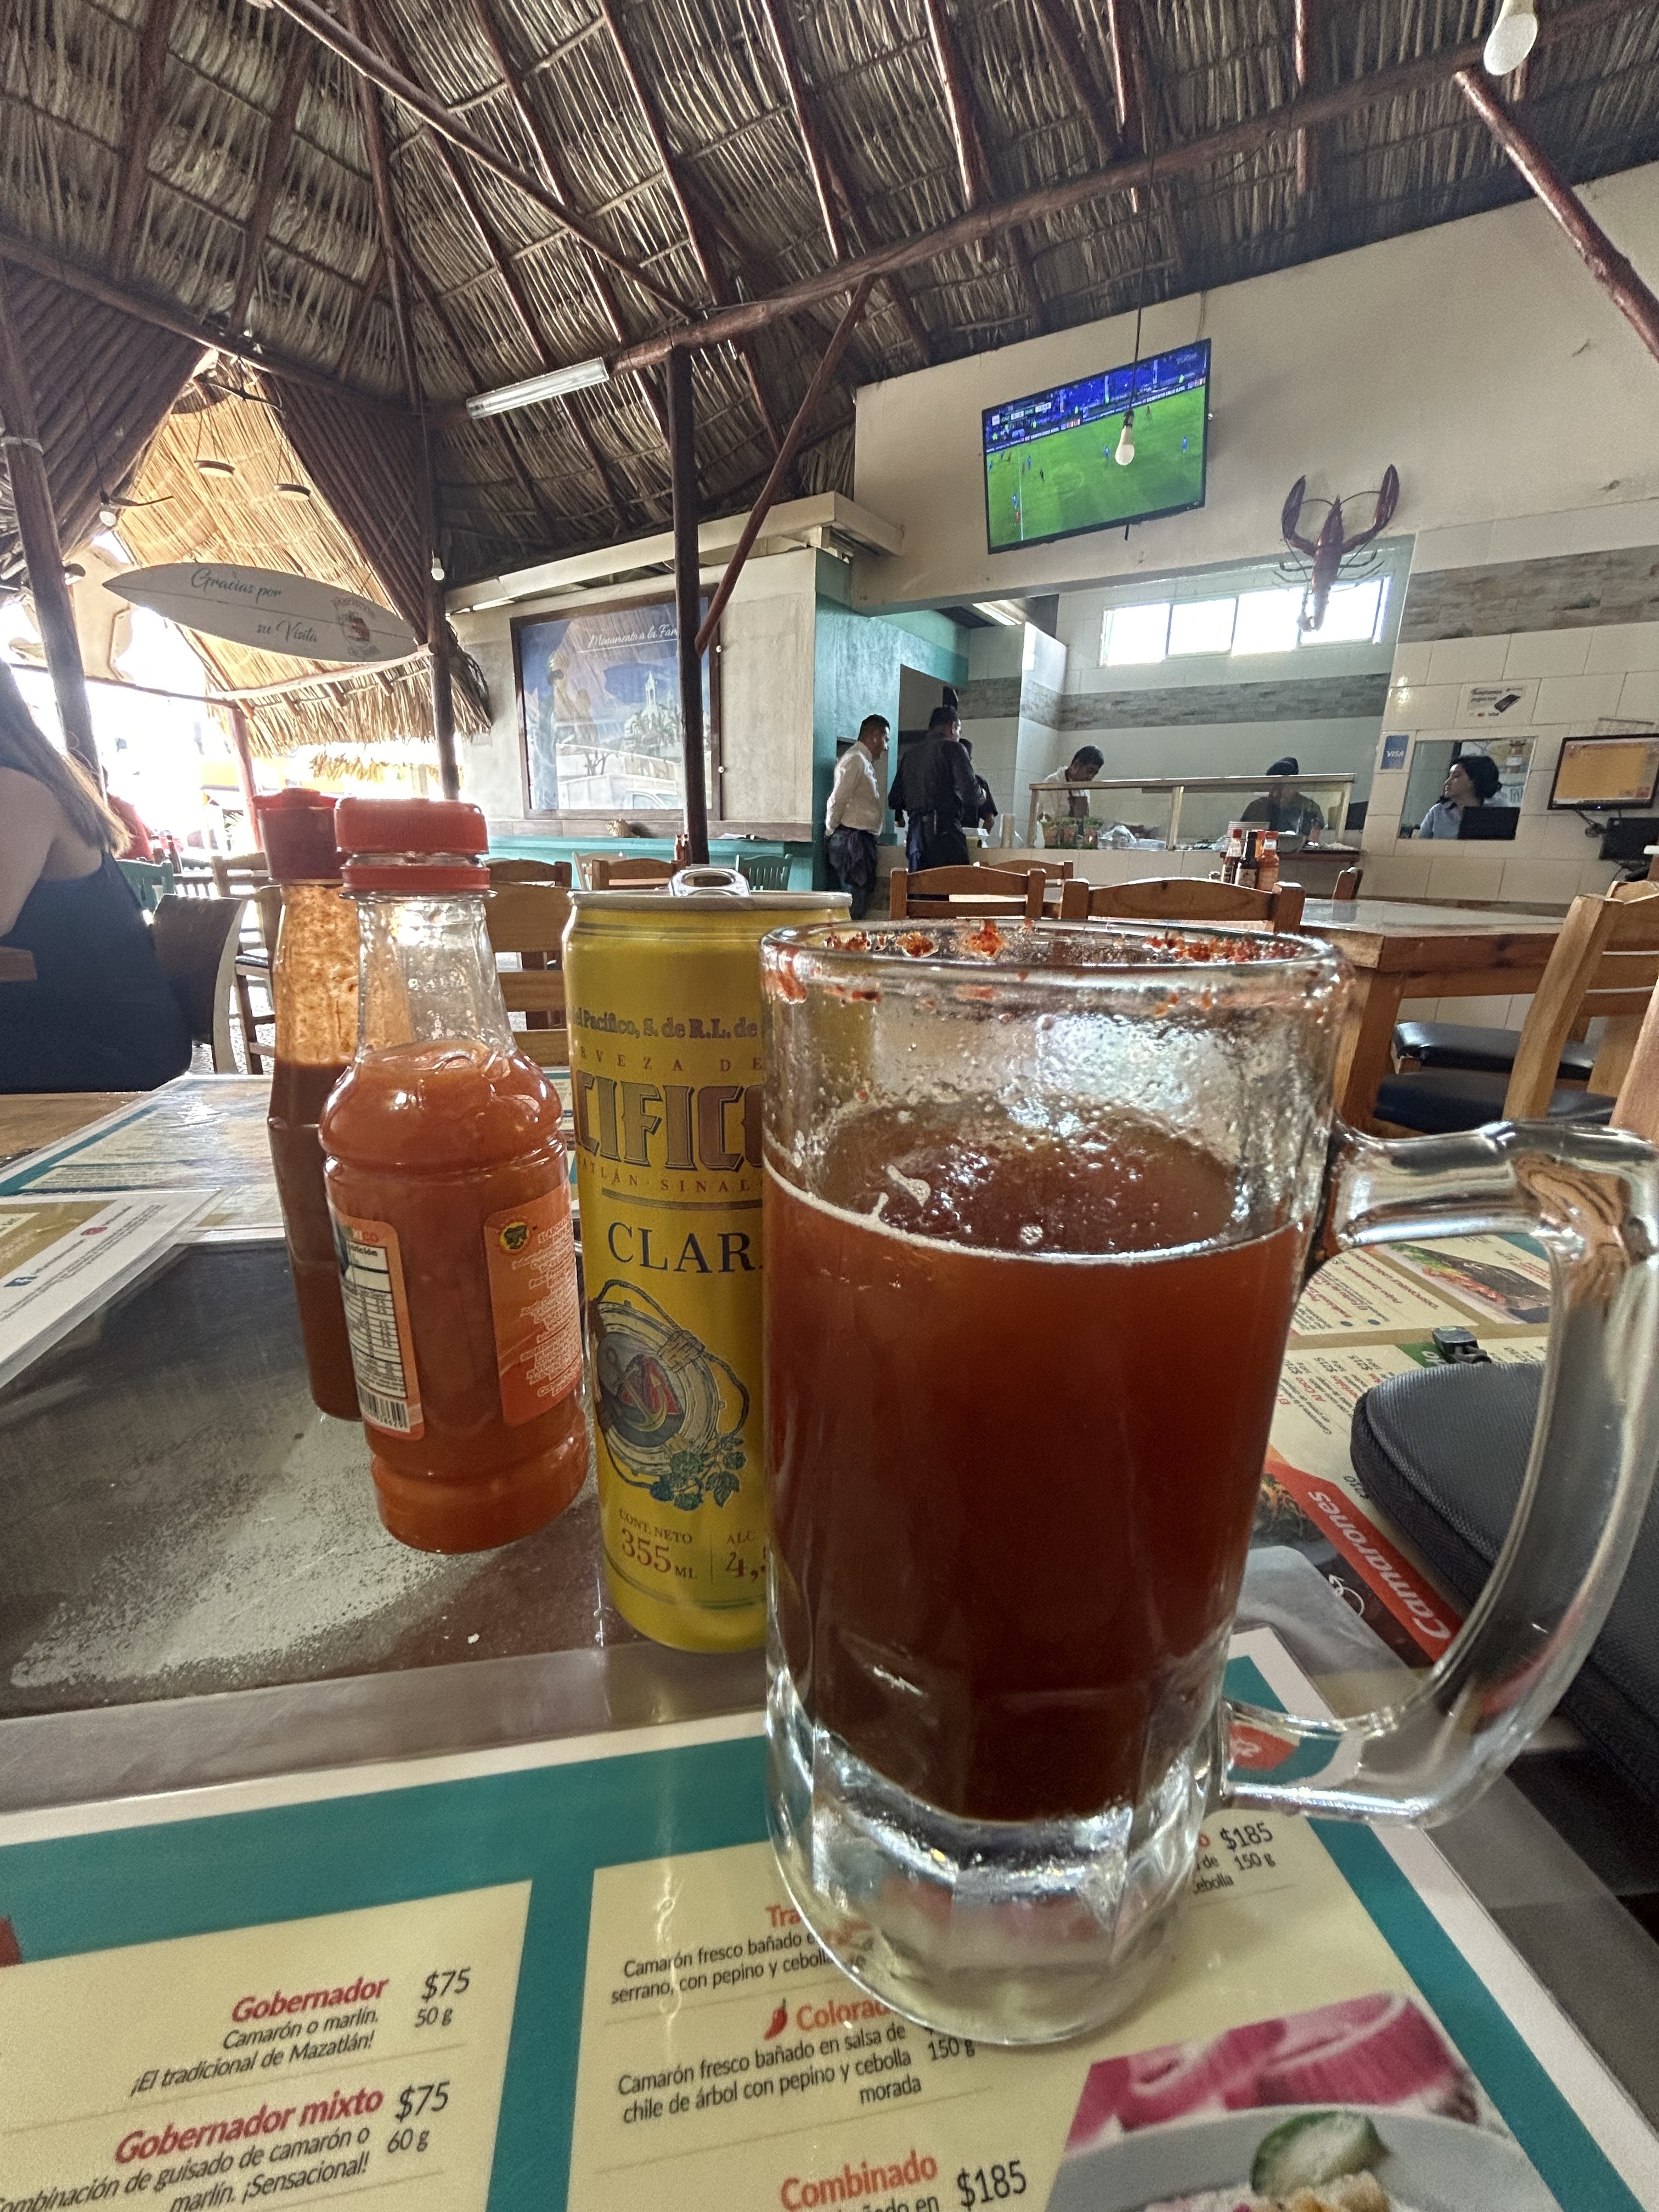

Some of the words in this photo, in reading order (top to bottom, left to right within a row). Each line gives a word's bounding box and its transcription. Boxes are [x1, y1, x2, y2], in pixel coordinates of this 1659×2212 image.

[191, 568, 253, 595] Gracias
[256, 585, 281, 605] por
[257, 622, 272, 635] su
[276, 621, 318, 644] Visita
[589, 630, 637, 649] Monumento
[647, 626, 657, 639] la
[643, 1017, 658, 1036] S.
[662, 1017, 686, 1038] de
[689, 1018, 731, 1039] R.L.
[733, 1017, 758, 1038] de
[720, 1057, 763, 1072] DE
[608, 1221, 763, 1274] CLAR
[1313, 1357, 1338, 1373] $215
[622, 1527, 672, 1573] 355
[675, 1566, 697, 1580] ML
[654, 1526, 693, 1545] NETO
[1307, 1491, 1452, 1640] Camarones
[1220, 1822, 1273, 1851] $185
[1204, 1854, 1220, 1870] de
[1234, 1852, 1262, 1870] 150
[624, 1950, 693, 1977] Camarón
[697, 1940, 743, 1965] fresco
[747, 1931, 802, 1956] bañado
[232, 1976, 390, 2023] Gobernador
[421, 1966, 471, 2002] $75
[611, 1981, 674, 2005] serrano,
[679, 1975, 708, 1991] con
[713, 1963, 764, 1990] pepino
[769, 1961, 777, 1979] y
[223, 2021, 302, 2051] Camarón
[307, 2019, 319, 2034] o
[323, 2007, 379, 2031] marlín.
[415, 2007, 439, 2028] 50
[129, 2068, 159, 2097] ¡El
[162, 2052, 255, 2087] tradicional
[260, 2046, 284, 2069] de
[288, 2030, 375, 2064] Mazatlán!
[618, 2063, 695, 2096] Camarón
[699, 2055, 749, 2080] fresco
[755, 2039, 815, 2068] bañado
[819, 2039, 840, 2056] en
[845, 2027, 882, 2051] salsa
[886, 2021, 906, 2041] de
[927, 2038, 961, 2063] 150
[623, 2093, 663, 2124] chile
[668, 2093, 690, 2114] de
[695, 2079, 739, 2108] árbol
[743, 2080, 774, 2099] con
[778, 2061, 836, 2096] pepino
[840, 2063, 850, 2083] y
[855, 2047, 912, 2076] cebolla
[859, 2075, 922, 2106] morada
[115, 2100, 297, 2165] Gobernador
[298, 2086, 384, 2128] mixto
[395, 2080, 450, 2123] $75
[123, 2168, 153, 2193] de
[154, 2153, 234, 2193] guisado
[238, 2145, 264, 2169] de
[269, 2129, 352, 2163] camarón
[357, 2126, 370, 2143] o
[387, 2128, 414, 2154] 60
[416, 2128, 431, 2152] g
[169, 2180, 236, 2212] marlín.
[242, 2151, 370, 2204] ¡Sensacional!
[780, 2148, 938, 2212] Combinado
[956, 2159, 1028, 2211] $185
